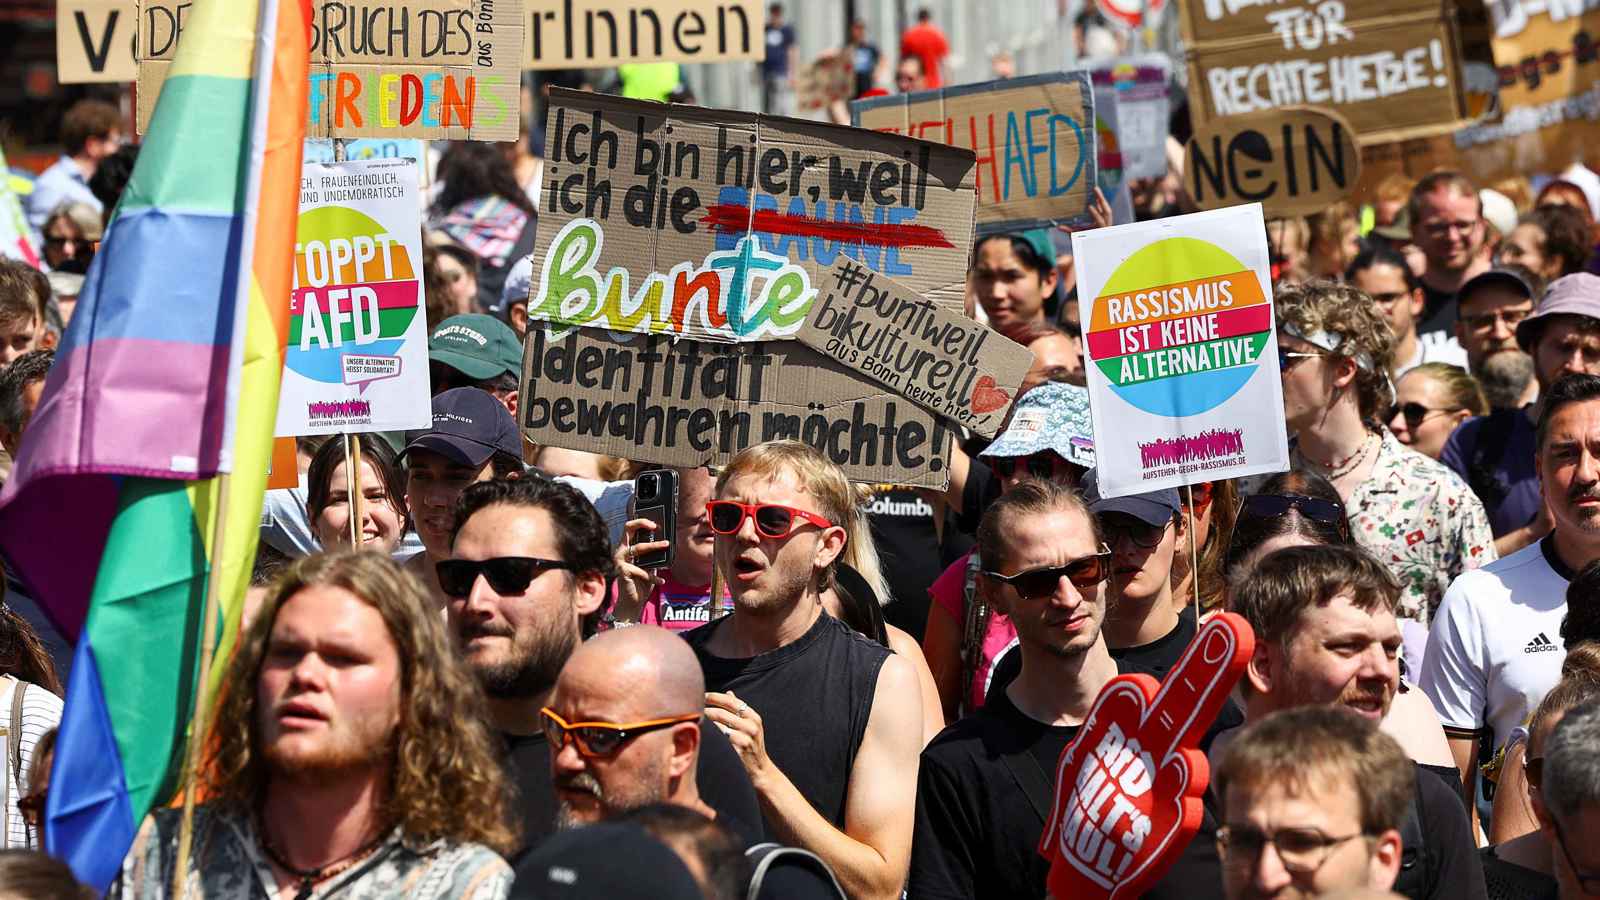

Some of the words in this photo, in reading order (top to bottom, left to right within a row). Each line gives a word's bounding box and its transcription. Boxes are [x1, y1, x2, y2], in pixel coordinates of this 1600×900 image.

[74, 10, 138, 73] V
[417, 9, 475, 58] DES
[476, 40, 494, 68] aus
[308, 71, 509, 130] FRIEDENS
[1207, 59, 1330, 117] RECHTE
[1328, 38, 1449, 105] HETZE!
[321, 173, 400, 189] FRAUENFEINDLICH,
[551, 109, 619, 169] Ich
[633, 115, 699, 180] bin
[716, 126, 820, 202] hier,
[828, 144, 931, 211] weil
[301, 192, 319, 203] UND
[324, 186, 404, 201] UNDEMOKRATISCH
[548, 167, 611, 219] ich
[623, 169, 700, 234] die
[300, 286, 381, 353] AFD
[1107, 279, 1233, 325] RASSISMUS
[812, 294, 978, 407] bikulturell
[1118, 323, 1152, 354] IST
[1160, 313, 1220, 348] KEINE
[531, 330, 772, 404] Identität
[825, 338, 858, 364] aus
[861, 356, 900, 387] Bonn
[903, 377, 943, 408] heute
[1119, 337, 1257, 385] ALTERNATIVE
[525, 379, 752, 455] bewahren
[762, 401, 948, 473] möchte!
[1142, 456, 1247, 481] AUFSTEHEN-GEGEN-RASSISMUS.DE
[663, 605, 710, 622] Antifa
[1524, 643, 1558, 654] adidas
